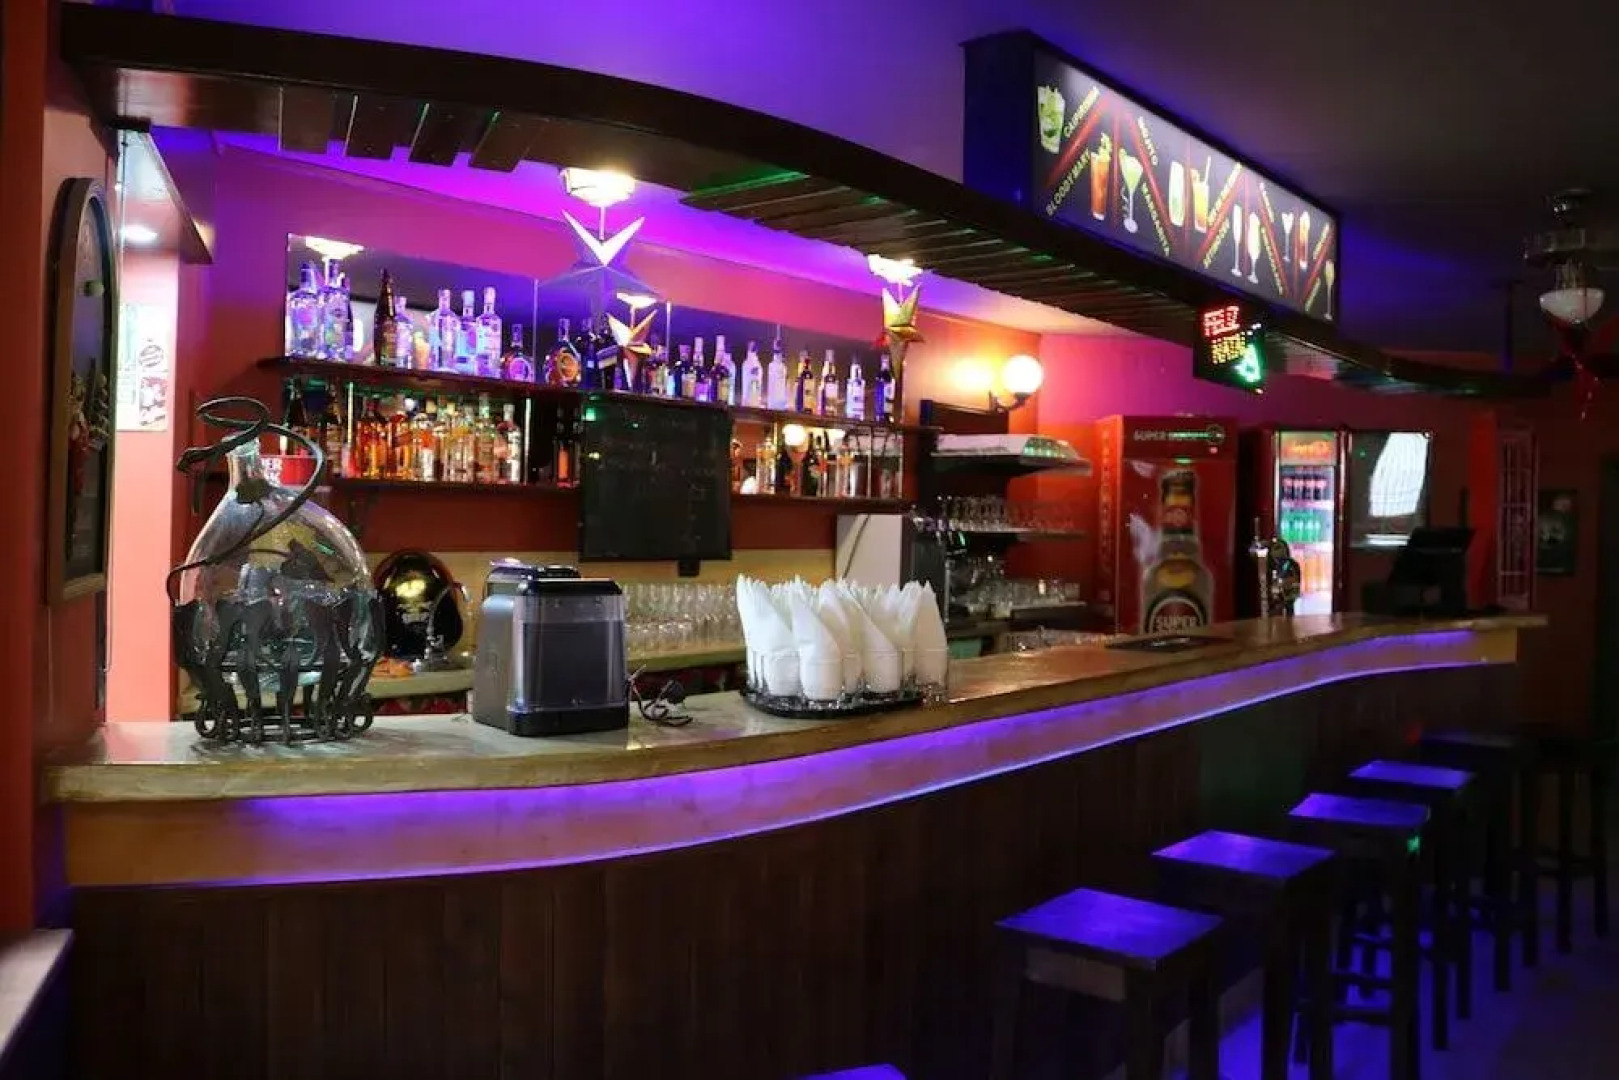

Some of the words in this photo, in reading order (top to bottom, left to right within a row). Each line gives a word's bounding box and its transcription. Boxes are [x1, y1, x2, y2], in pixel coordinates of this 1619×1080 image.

[1046, 171, 1074, 216] BLOODY
[1133, 429, 1167, 441] SUPER
[1155, 614, 1198, 634] SUPER
